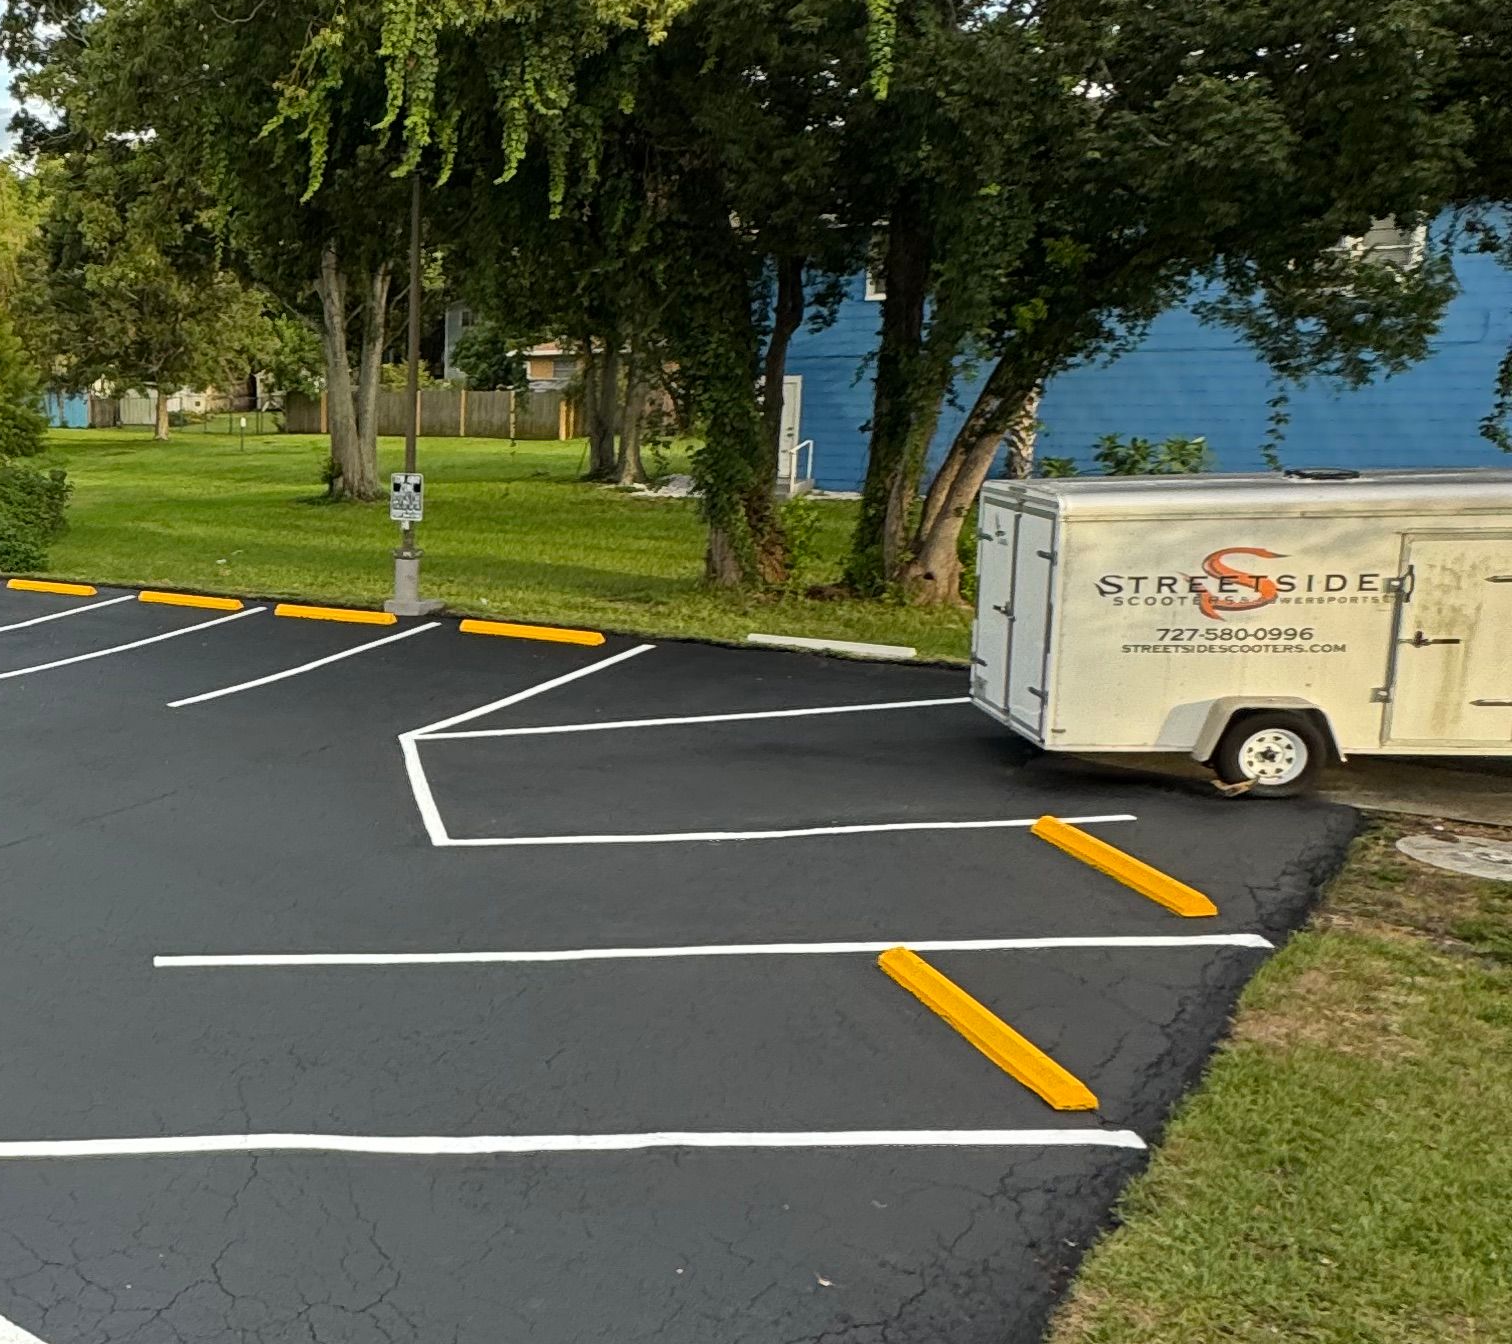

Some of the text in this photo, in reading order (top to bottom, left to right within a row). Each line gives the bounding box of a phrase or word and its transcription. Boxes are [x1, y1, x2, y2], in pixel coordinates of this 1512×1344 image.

[1093, 573, 1380, 598] STREETSIDE
[1112, 596, 1234, 607] SCOOTERS
[1255, 596, 1381, 605] WERSPORTS
[1157, 627, 1315, 642] 727-580-0996
[1121, 643, 1347, 654] STREETSIDESCOOTERS.COM
